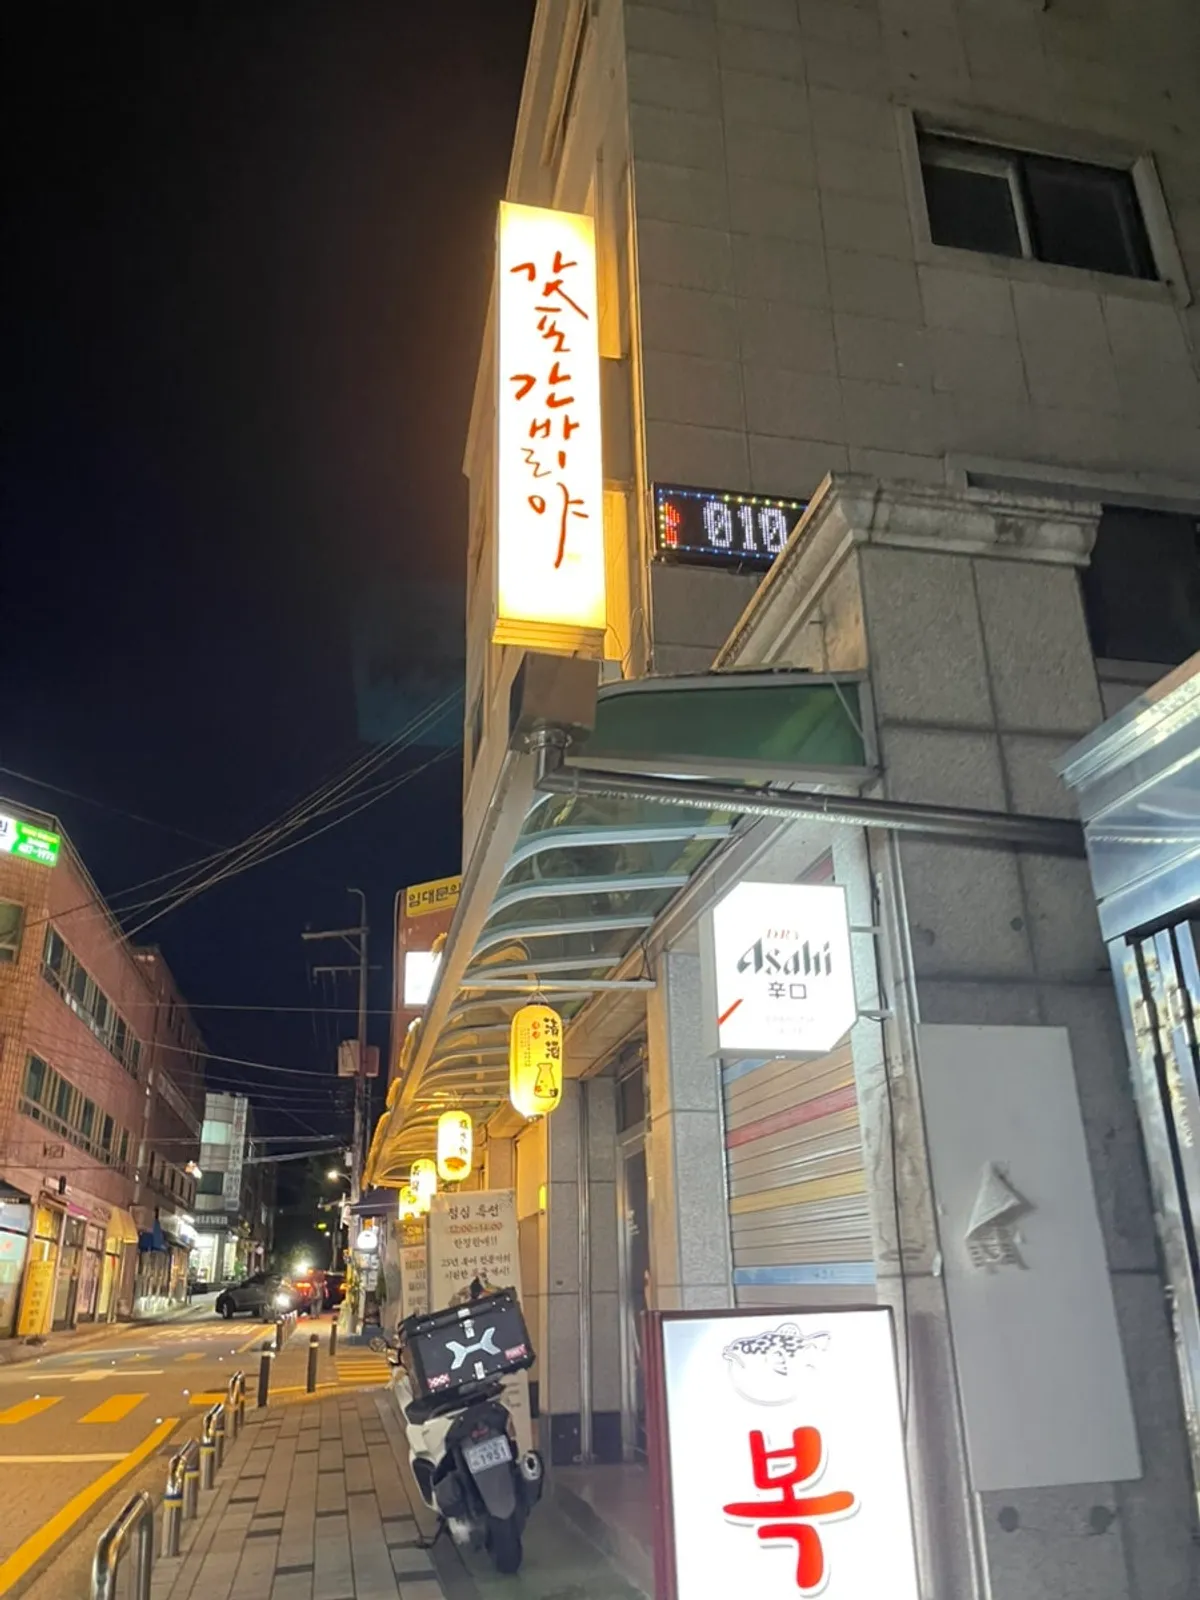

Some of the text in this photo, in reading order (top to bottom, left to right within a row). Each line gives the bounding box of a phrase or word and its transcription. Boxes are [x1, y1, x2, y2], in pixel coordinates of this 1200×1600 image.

[703, 501, 788, 553] 010
[736, 937, 833, 977] Asahi
[768, 981, 807, 999] 辛口
[722, 1424, 858, 1592] 복
